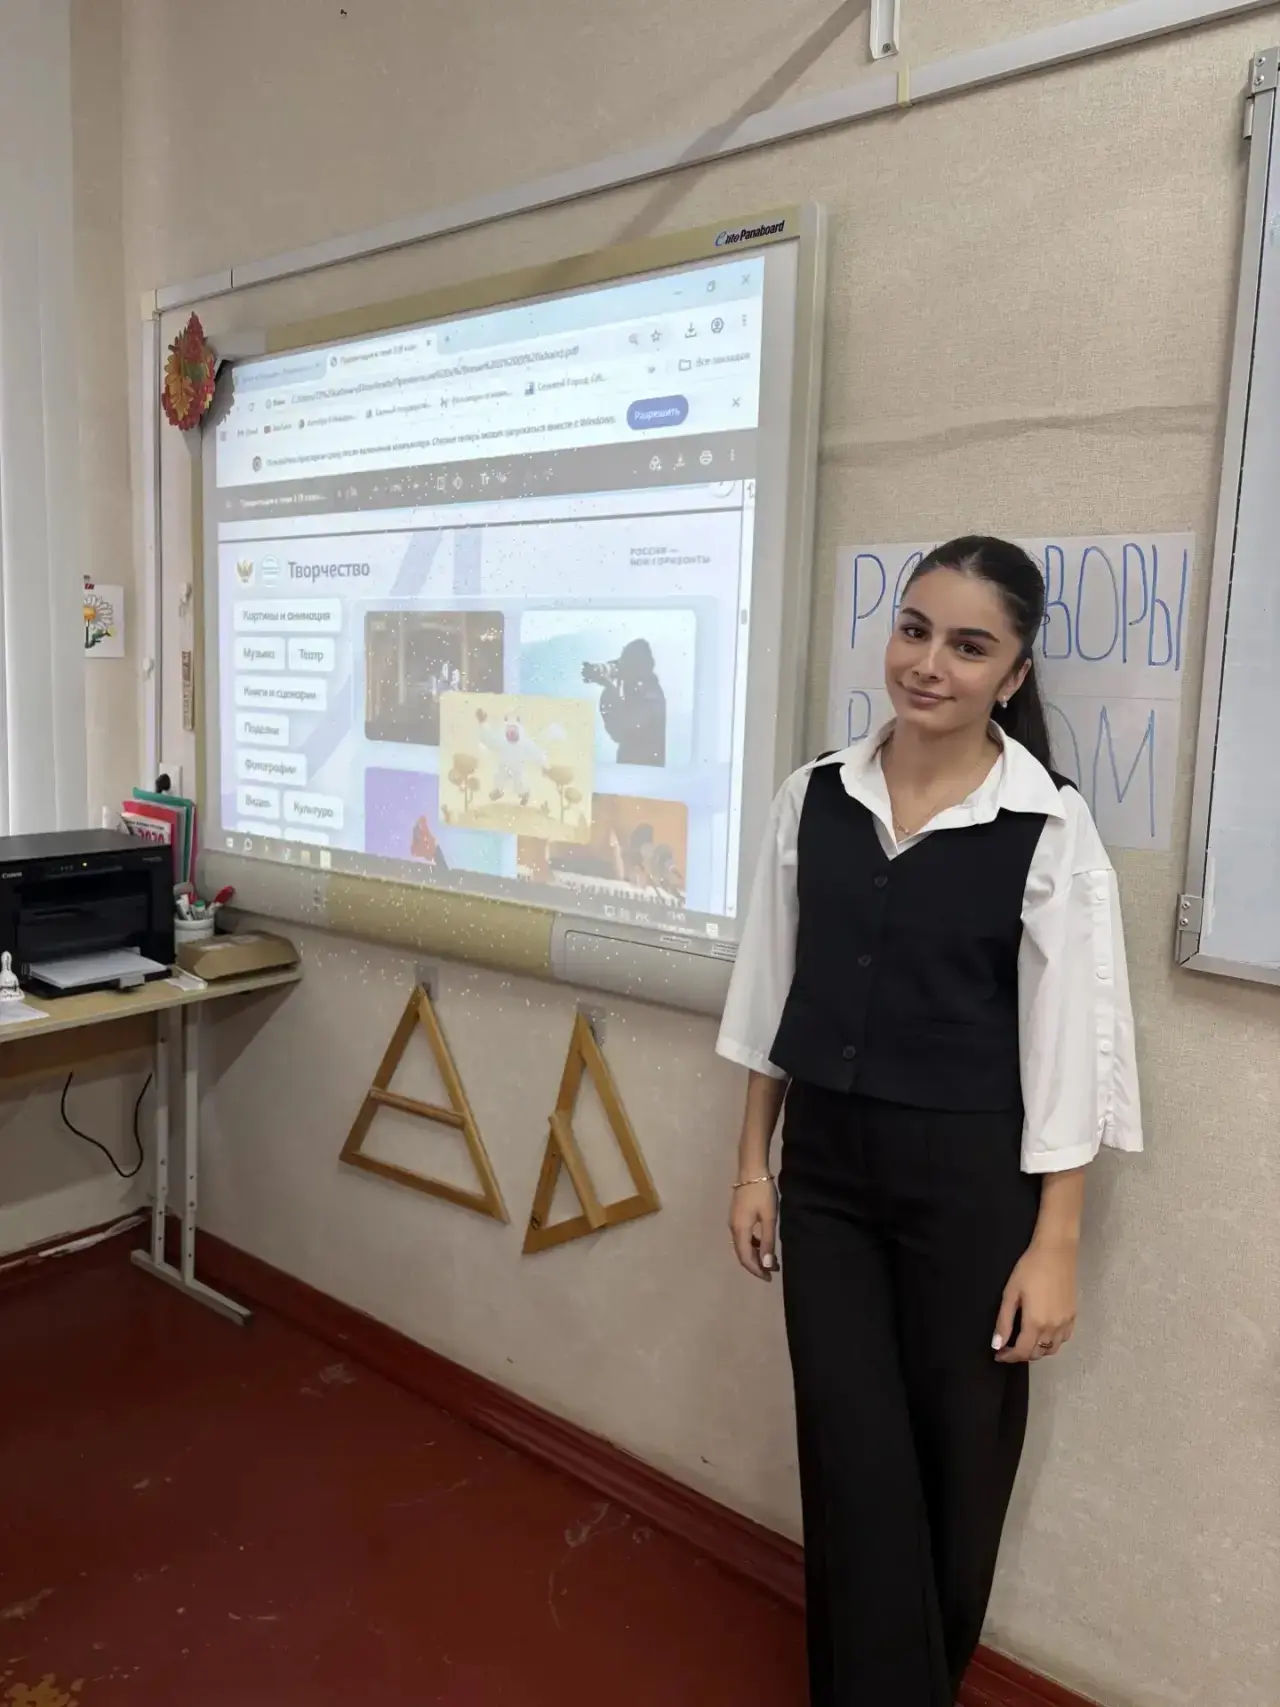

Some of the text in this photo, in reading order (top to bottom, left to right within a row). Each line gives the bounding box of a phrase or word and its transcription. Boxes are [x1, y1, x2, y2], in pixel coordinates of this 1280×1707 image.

[740, 219, 786, 241] Panaboard
[634, 406, 681, 421] Разрешить
[287, 560, 371, 583] Творчество
[243, 648, 275, 661] Музыка
[299, 648, 324, 663] Театр
[243, 687, 268, 698] Книги
[276, 690, 317, 703] сценарии
[244, 722, 279, 736] Поделки
[245, 758, 297, 776] Фотографии
[245, 794, 272, 808] Видео
[293, 801, 334, 819] Культура
